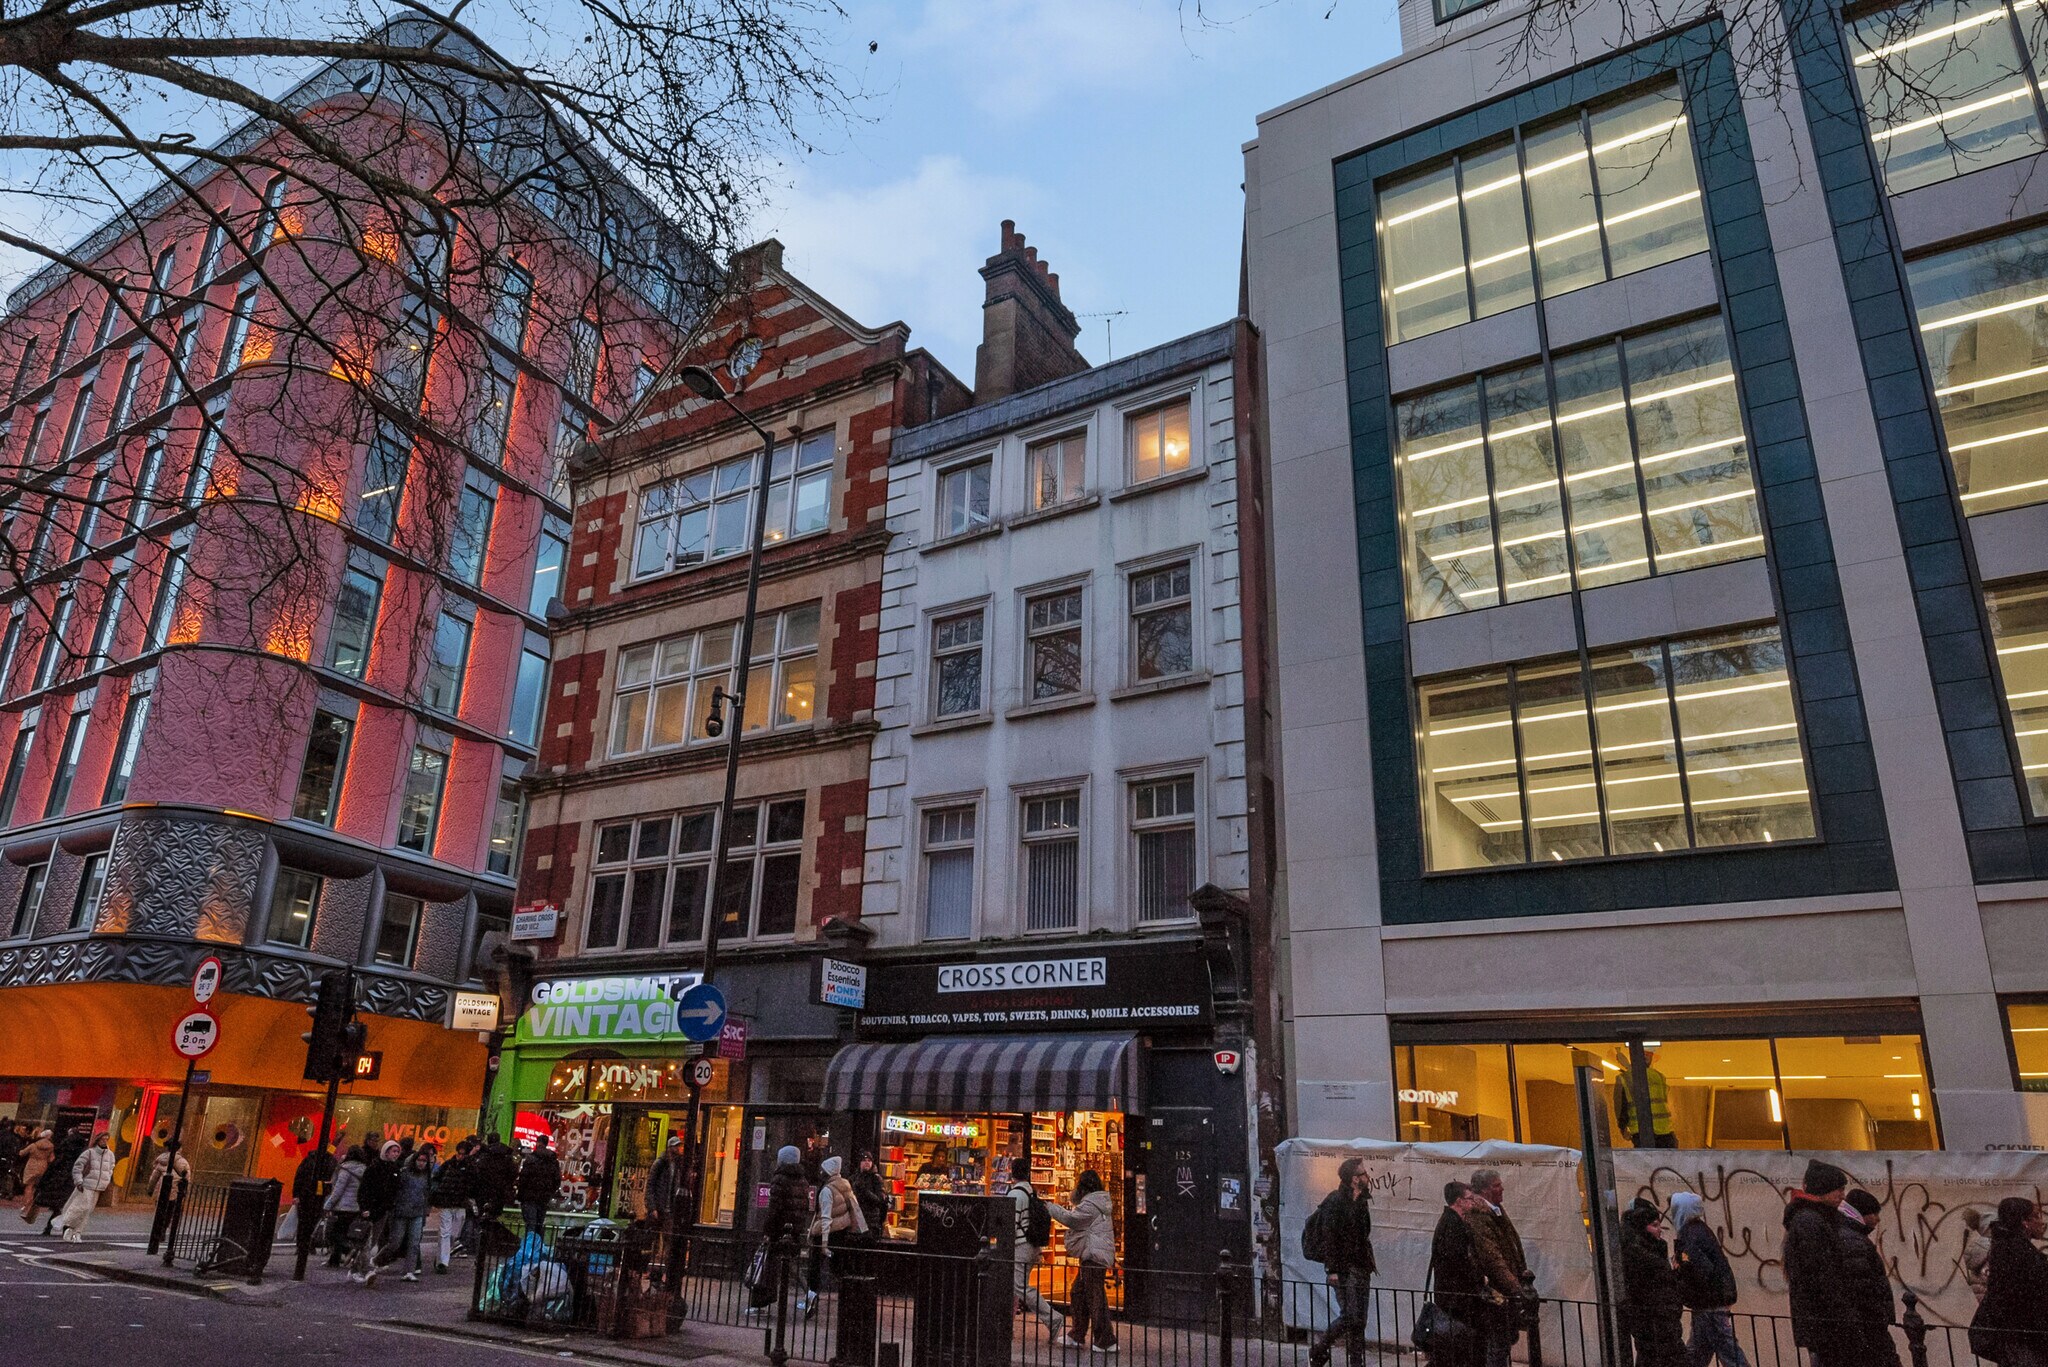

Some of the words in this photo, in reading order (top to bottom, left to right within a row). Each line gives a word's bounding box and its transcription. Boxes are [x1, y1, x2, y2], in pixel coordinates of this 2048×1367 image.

[517, 915, 537, 923] CHARING
[830, 961, 860, 975] Tobacco
[939, 966, 1006, 988] CROSS
[1011, 961, 1104, 984] CORNER
[828, 972, 860, 987] Essentials
[532, 973, 703, 1004] GOLDSMIT
[827, 984, 859, 997] MONEY
[457, 999, 497, 1007] GOLDSMITH
[462, 1008, 491, 1016] VINTAGE
[861, 1016, 908, 1025] SOUVENIRS,
[910, 1014, 950, 1024] TOBACCO,
[953, 1013, 981, 1023] VAPES,
[983, 1012, 1008, 1022] TOYS,
[1009, 1010, 1049, 1021] SWEETS,
[1051, 1009, 1089, 1020] DRINKS,
[1091, 1008, 1128, 1018] MOBILE
[1130, 1005, 1200, 1017] ACCESSORIES
[723, 1025, 744, 1040] SRC
[358, 1058, 372, 1073] 04
[696, 1066, 711, 1079] 20
[384, 1123, 477, 1144] WELCOM
[927, 1124, 950, 1134] PHONE
[951, 1125, 978, 1136] REPAIRS
